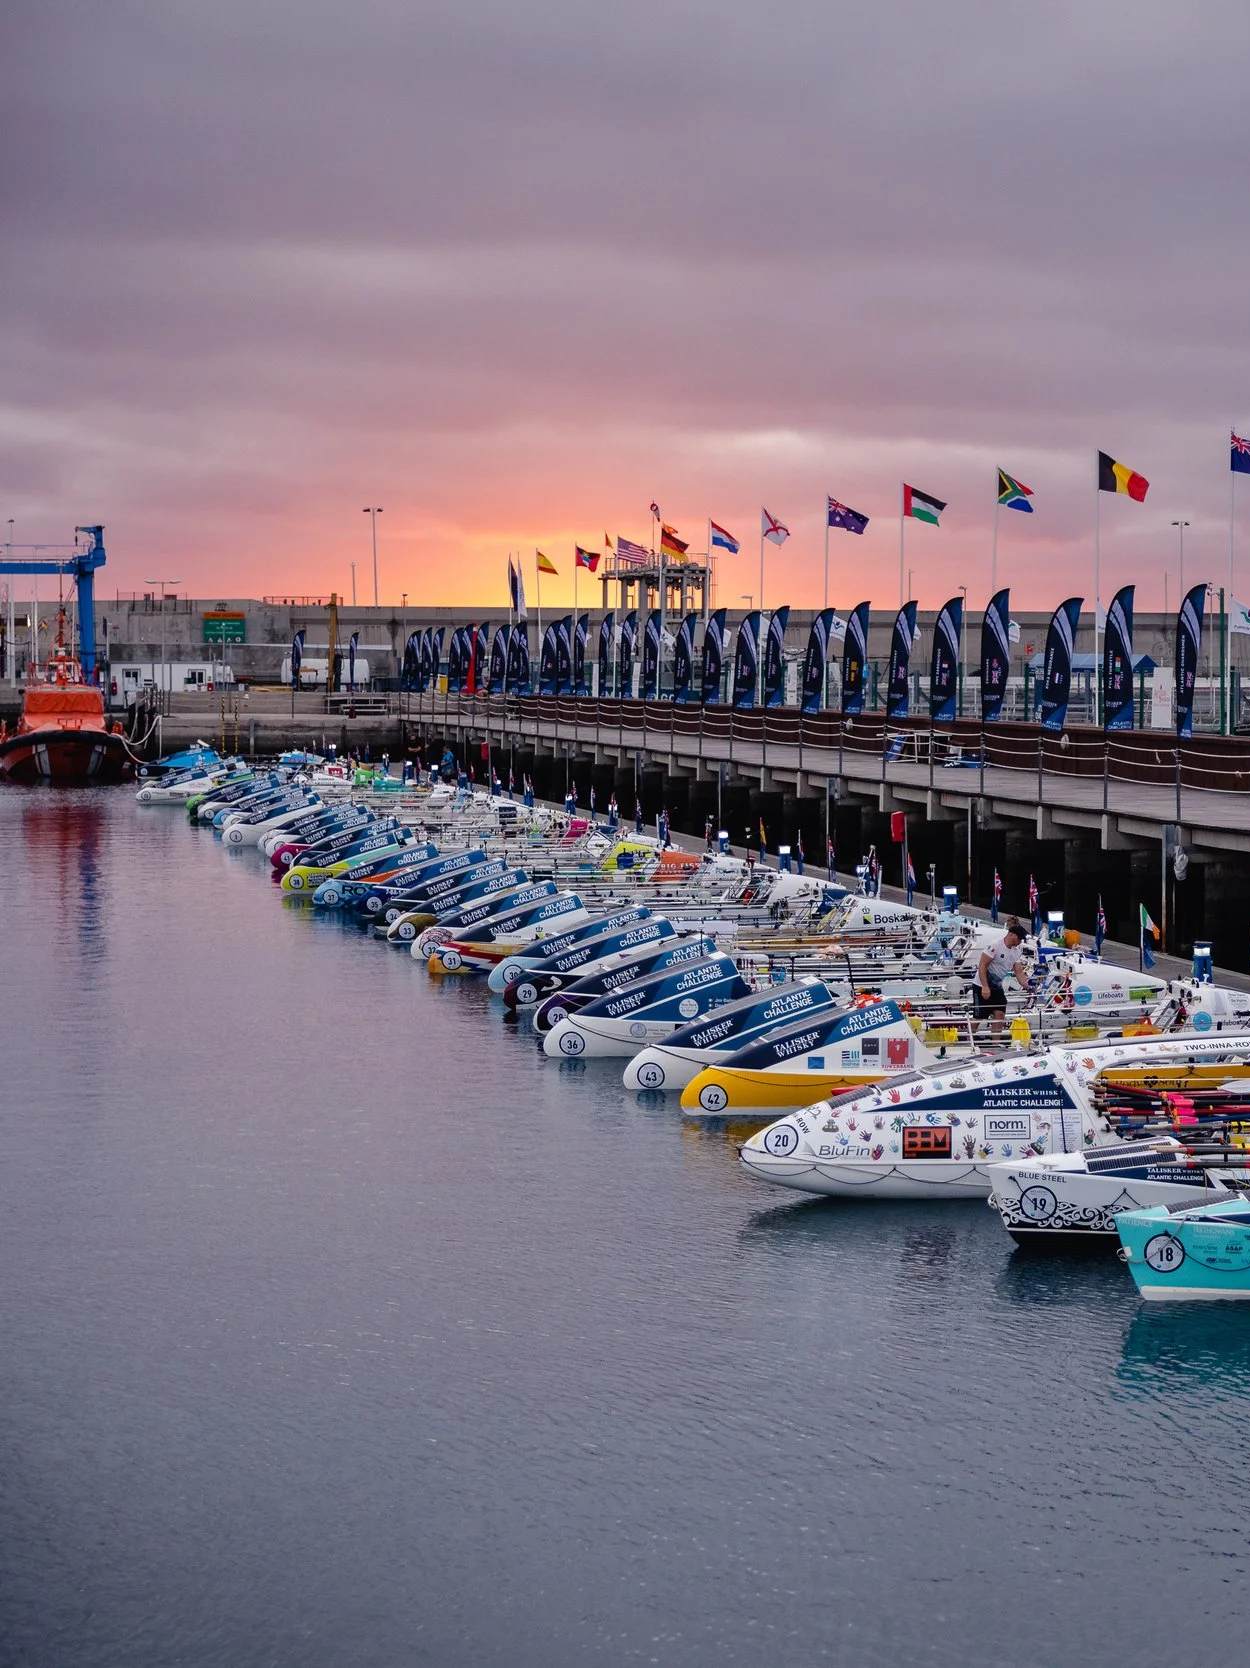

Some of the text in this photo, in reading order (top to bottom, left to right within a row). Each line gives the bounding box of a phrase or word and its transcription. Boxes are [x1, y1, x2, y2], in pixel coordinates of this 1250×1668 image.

[484, 878, 518, 893] CHALLENGE
[488, 874, 516, 886] ATLANTIC
[512, 891, 548, 906] CHALLENGE
[518, 886, 547, 899] ATLANTIC
[370, 900, 378, 908] 35
[539, 904, 576, 919] CHALLENGE
[545, 898, 575, 912] ATLANTIC
[460, 906, 490, 921] TALISKER
[608, 912, 639, 926] ATLANTIC
[620, 929, 662, 948] CHALLENGE
[626, 924, 660, 938] ATLANTIC
[542, 934, 576, 952] TALISKER
[673, 942, 708, 958] ATLANTIC
[448, 957, 456, 966] 31
[556, 948, 591, 967] TALISKER
[558, 956, 588, 971] WHISKY
[602, 966, 640, 985] TALISKER
[683, 964, 721, 980] ATLANTIC
[604, 974, 636, 990] WHISKY
[676, 970, 724, 990] CHALLENGE
[522, 990, 532, 998] 29
[770, 990, 811, 1008] ATLANTIC
[1098, 992, 1124, 1000] Lifeboats
[606, 992, 646, 1012] TALISKER
[608, 1000, 642, 1016] WHISKY
[764, 997, 814, 1020] CHALLENGE
[848, 1006, 890, 1025] ATLANTIC
[690, 1019, 734, 1042] TALISKER
[840, 1012, 894, 1035] CHALLENGE
[567, 1040, 578, 1050] 36
[694, 1029, 730, 1048] WHISKY
[773, 1032, 820, 1052] TALISKER
[776, 1040, 815, 1058] WHISKY
[645, 1071, 657, 1082] 43
[707, 1094, 720, 1105] 42
[982, 1088, 1032, 1096] TALISKER
[983, 1100, 1018, 1108] ATLANTIC
[990, 1119, 1027, 1130] norm.
[774, 1134, 789, 1148] 20
[819, 1145, 870, 1156] BluFin
[1018, 1171, 1067, 1183] BLUE STEEL
[1032, 1198, 1047, 1211] 19
[1118, 1218, 1153, 1228] PATIENCE
[1158, 1247, 1174, 1262] 18
